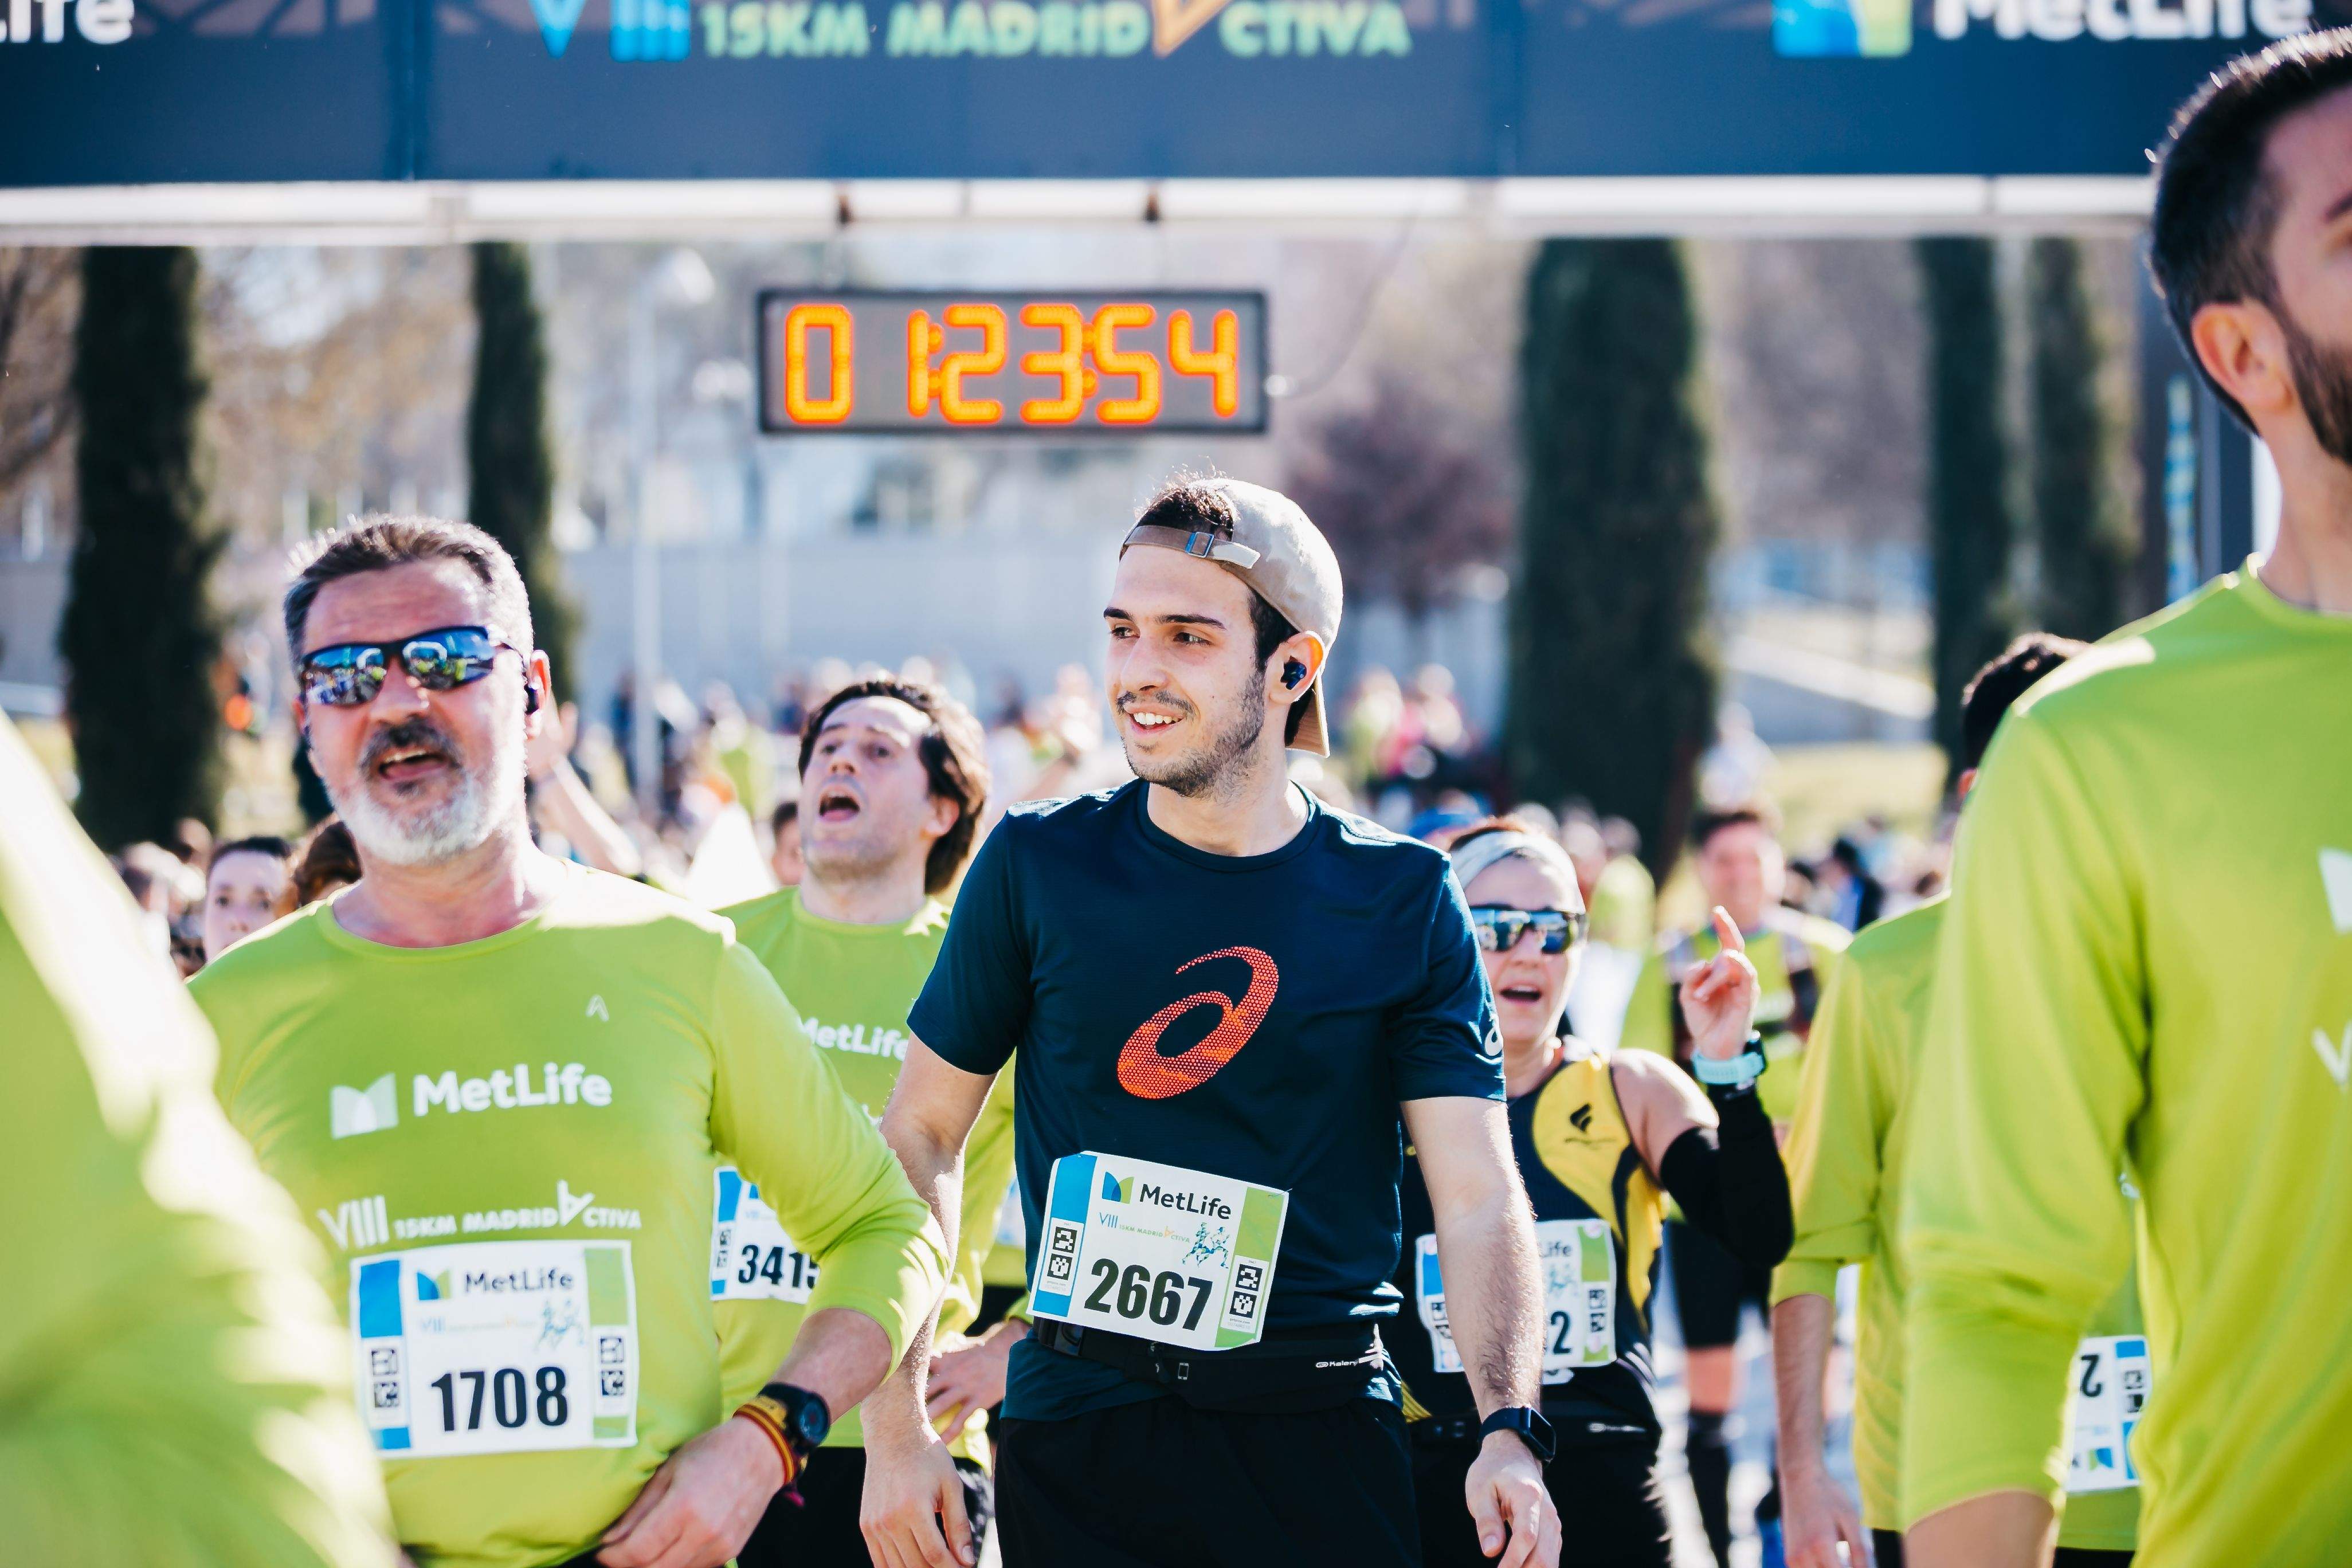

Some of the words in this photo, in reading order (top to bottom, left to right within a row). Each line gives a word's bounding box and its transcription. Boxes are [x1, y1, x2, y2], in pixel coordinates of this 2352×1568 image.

[701, 1, 870, 57] 15KM
[884, 1, 1148, 57] MADRID
[413, 1063, 612, 1117] MetLife
[317, 1195, 389, 1249] VIII
[462, 1208, 558, 1232] MADRID
[1099, 1212, 1119, 1228] VIII
[1137, 1228, 1163, 1237] MADRID
[1139, 1183, 1232, 1220] MetLife
[465, 1267, 574, 1293] MetLife
[1084, 1259, 1213, 1331] 2667
[431, 1366, 569, 1432] 1708
